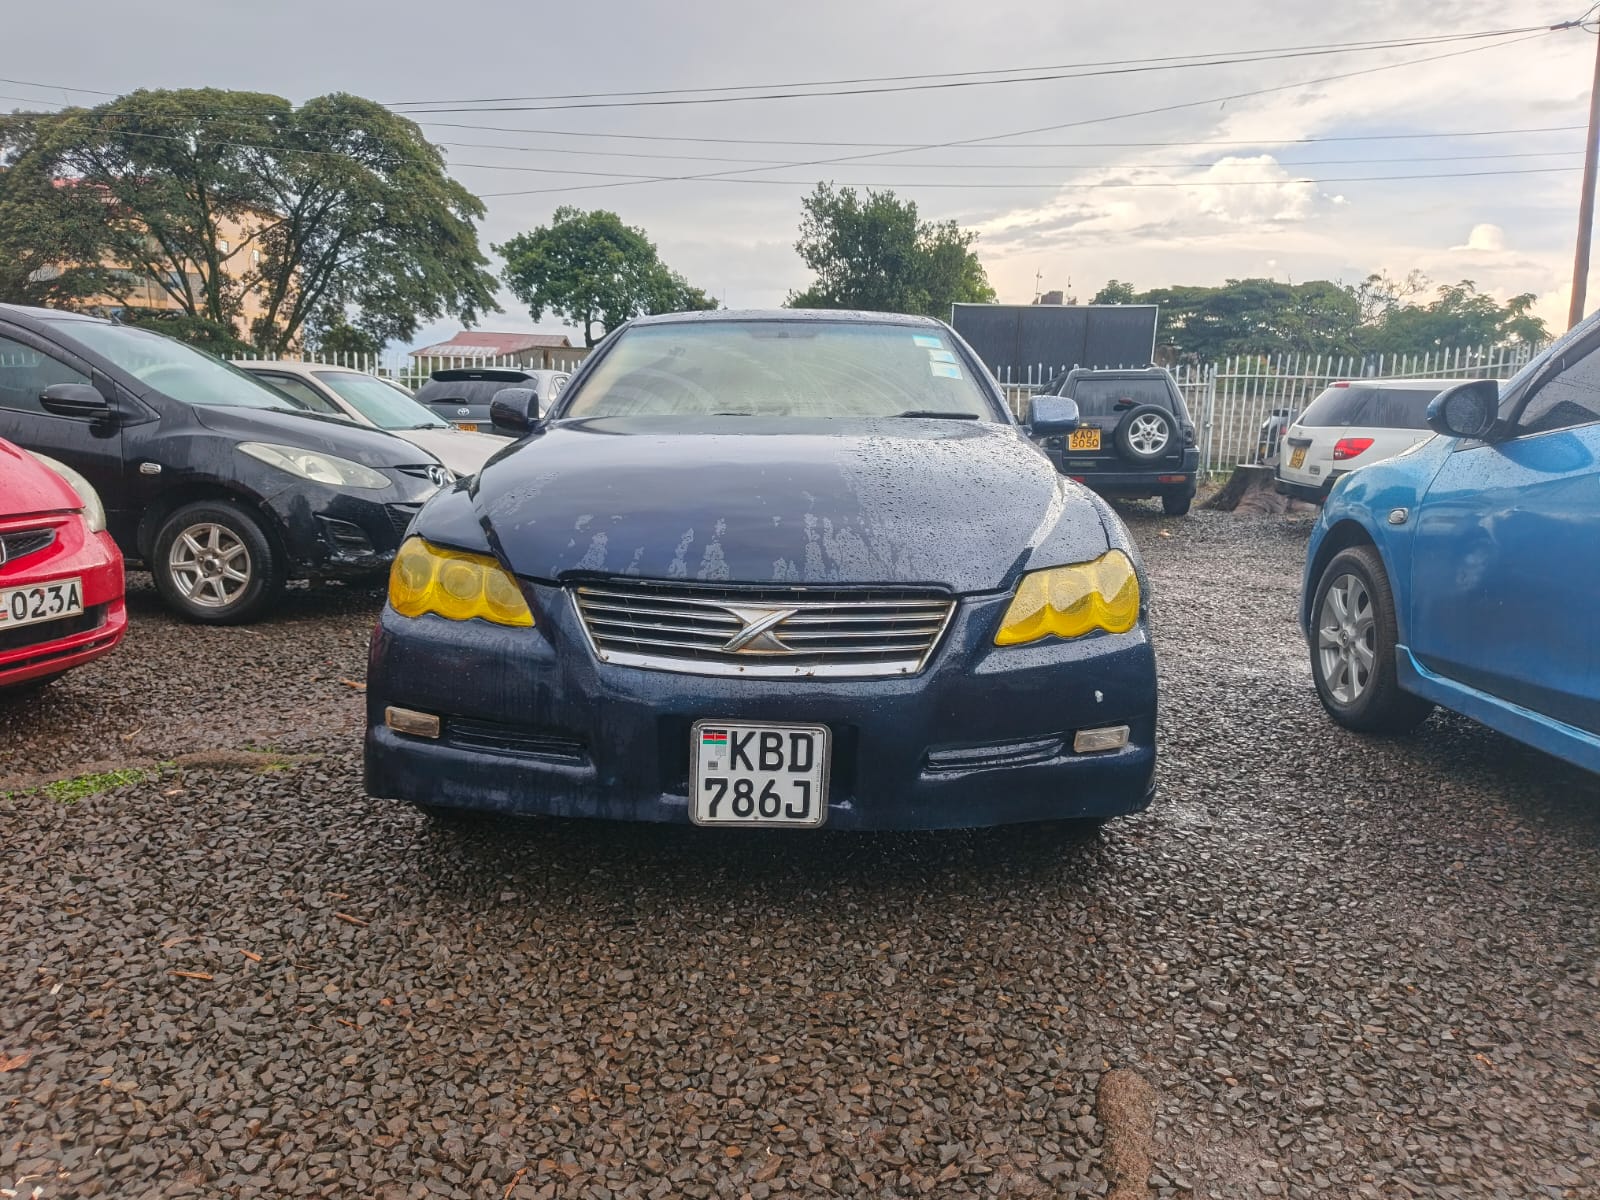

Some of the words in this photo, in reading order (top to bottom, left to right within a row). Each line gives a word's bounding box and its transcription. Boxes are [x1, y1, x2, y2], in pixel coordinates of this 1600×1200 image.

[11, 583, 81, 621] 023A
[730, 730, 814, 773] KBD
[704, 777, 811, 819] 786J
